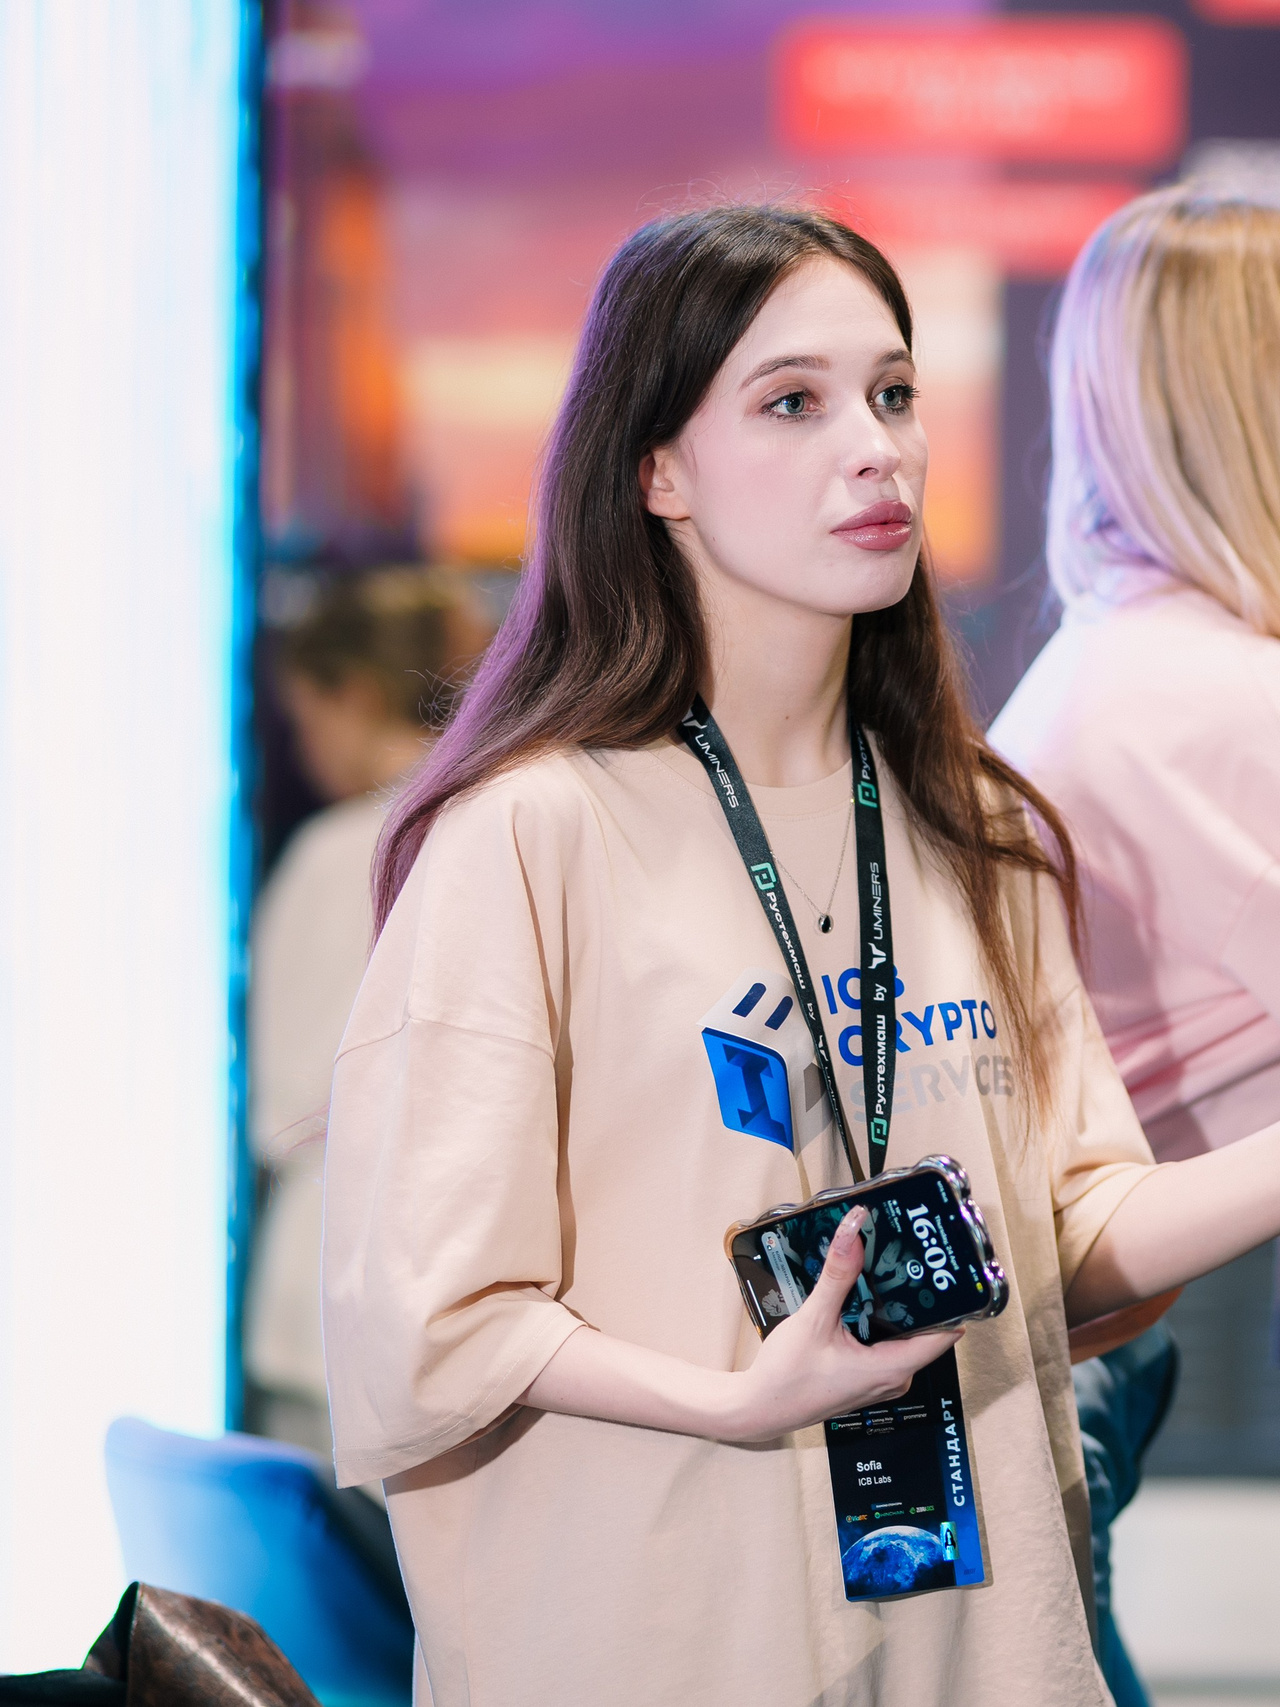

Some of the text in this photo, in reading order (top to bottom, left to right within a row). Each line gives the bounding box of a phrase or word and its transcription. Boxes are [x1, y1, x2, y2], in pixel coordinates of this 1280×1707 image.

[695, 733, 739, 809] UMINERS
[766, 891, 806, 990] Рустехмаш
[806, 1002, 817, 1021] by
[871, 861, 888, 1115] Рустехмаш by UMINERS
[906, 1203, 957, 1291] 16:06
[946, 1245, 954, 1256] 24
[950, 1255, 960, 1271] April
[856, 1460, 882, 1472] Sofia
[858, 1475, 892, 1487] ICB Labs
[941, 1397, 966, 1507] СТАНДАРТ
